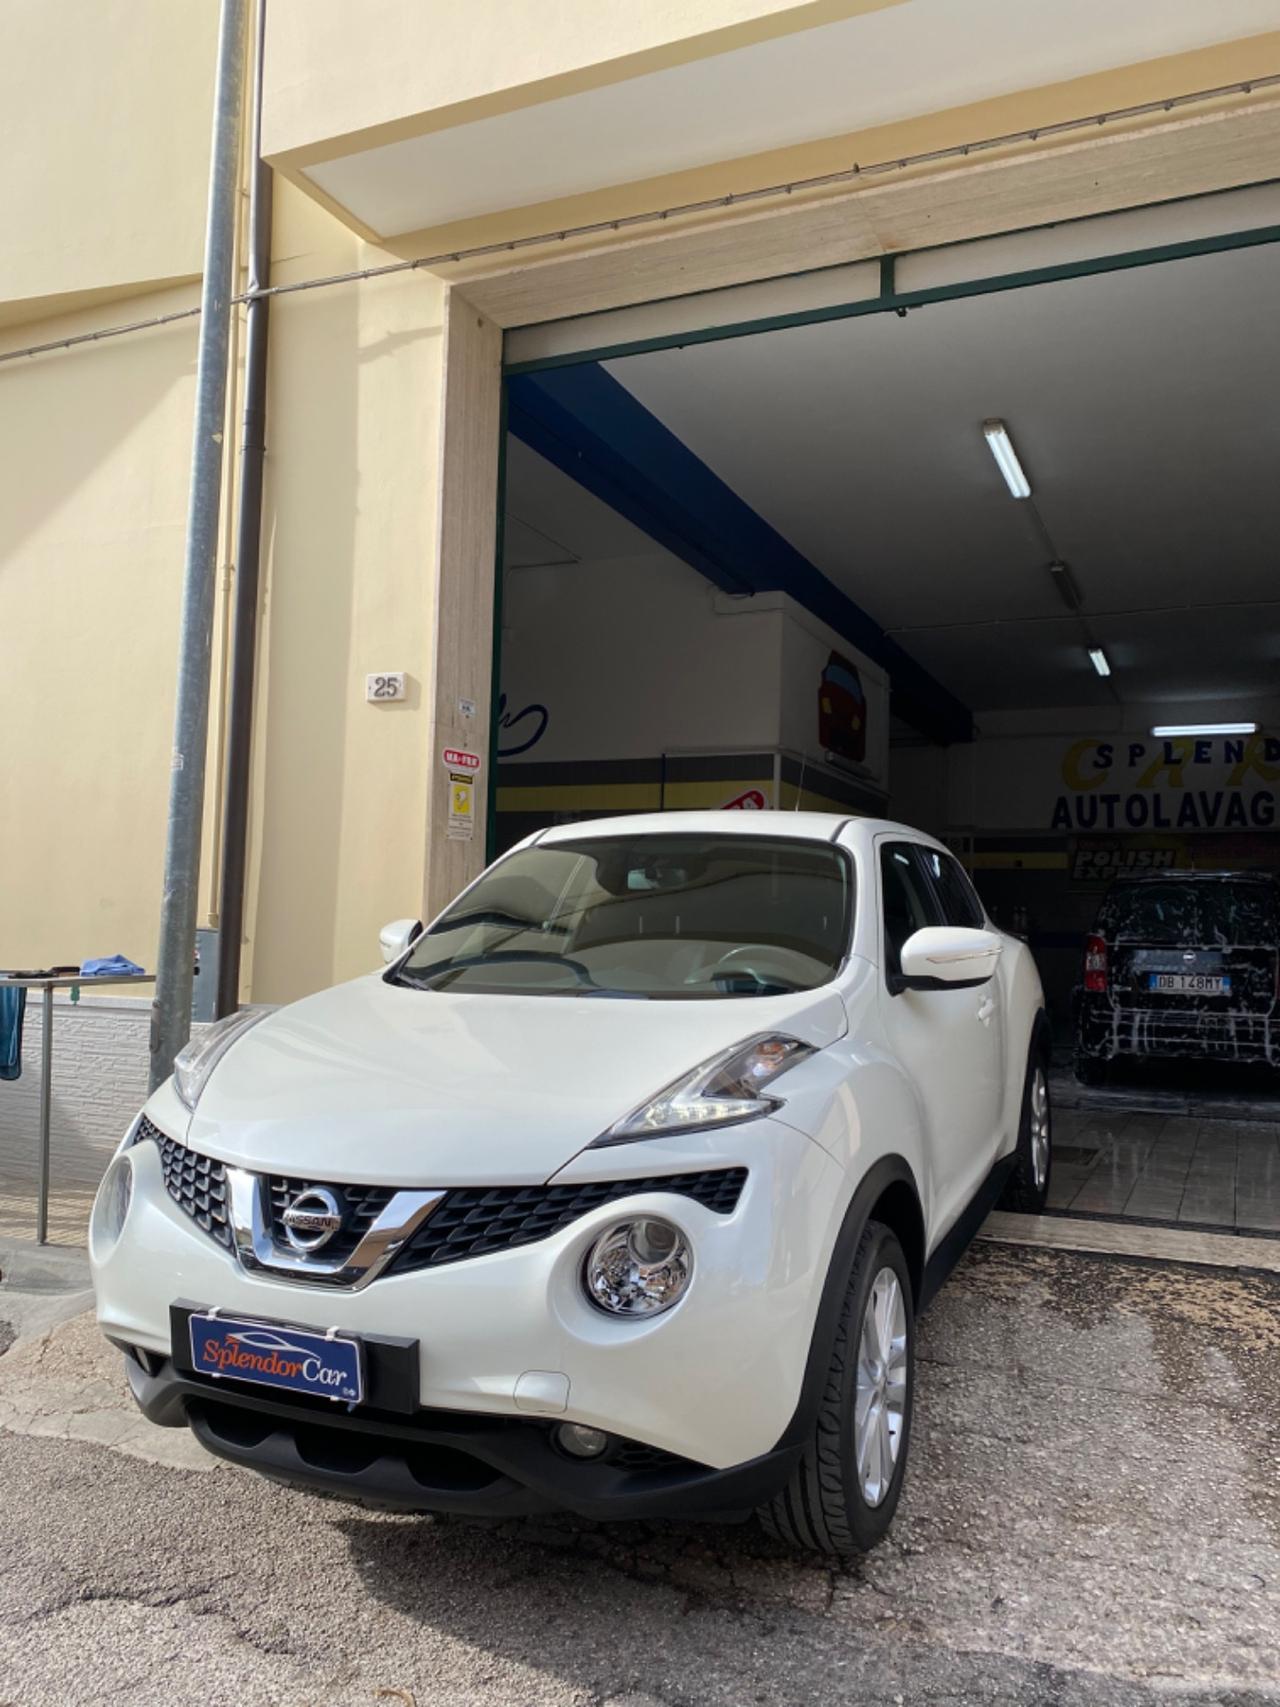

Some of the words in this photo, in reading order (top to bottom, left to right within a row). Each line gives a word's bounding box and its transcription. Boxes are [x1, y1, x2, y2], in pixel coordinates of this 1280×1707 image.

[374, 677, 398, 697] 25
[1051, 790, 1274, 829] AUTOLAVAG
[1075, 849, 1176, 867] POLISH
[1159, 976, 1174, 988] DB
